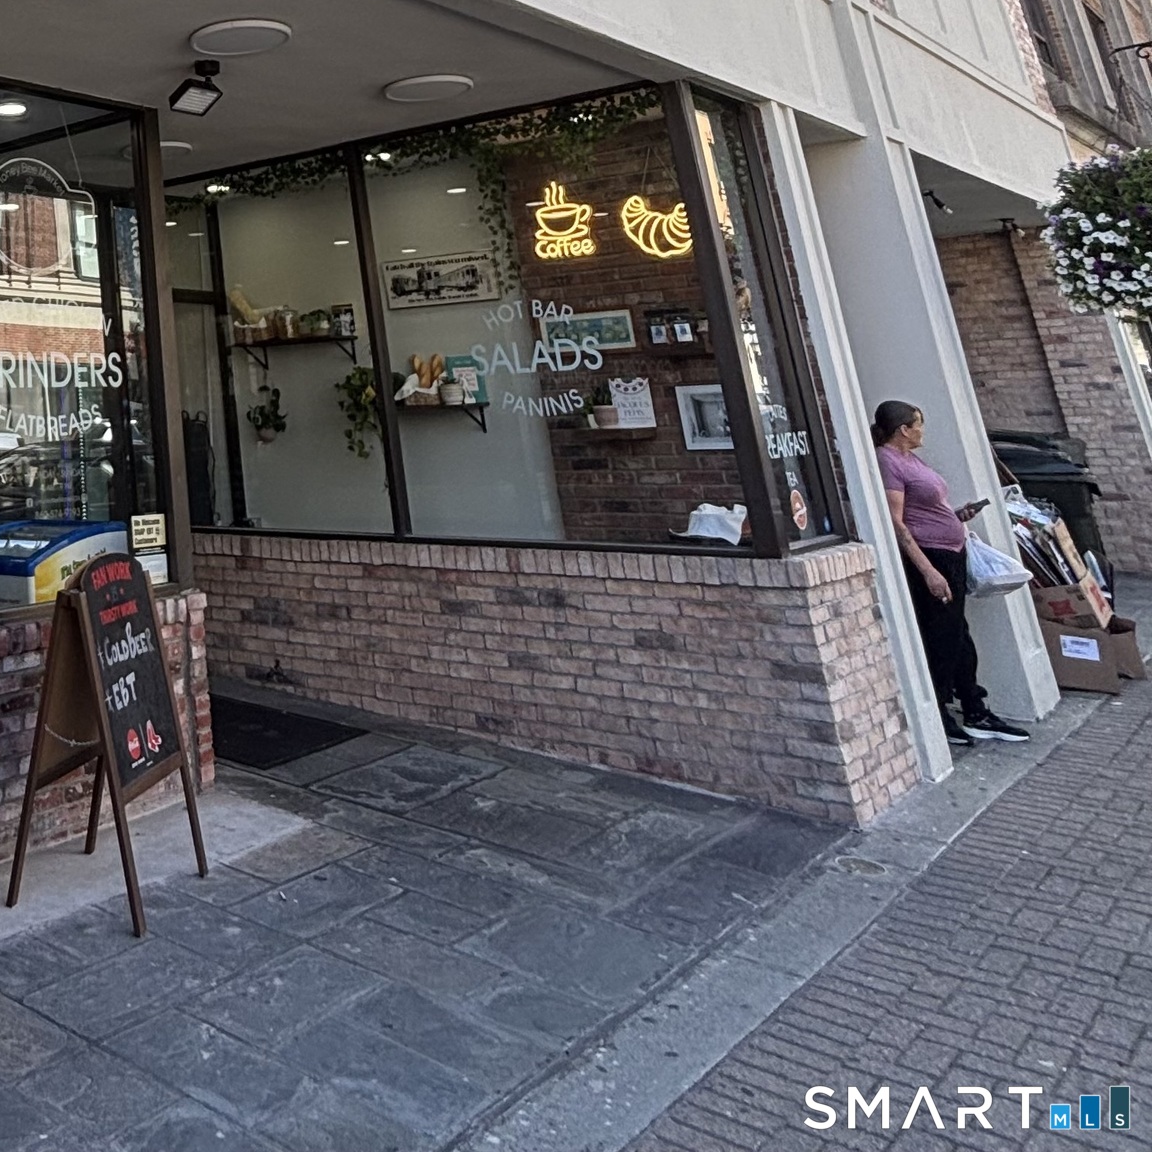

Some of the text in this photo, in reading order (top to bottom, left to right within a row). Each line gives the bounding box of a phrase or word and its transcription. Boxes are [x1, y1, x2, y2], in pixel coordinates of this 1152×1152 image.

[20, 162, 39, 176] Bee
[481, 298, 575, 330] HOT BAR
[471, 335, 605, 377] SALADS
[502, 388, 586, 418] PANINIS
[765, 431, 810, 459] REAKFAST
